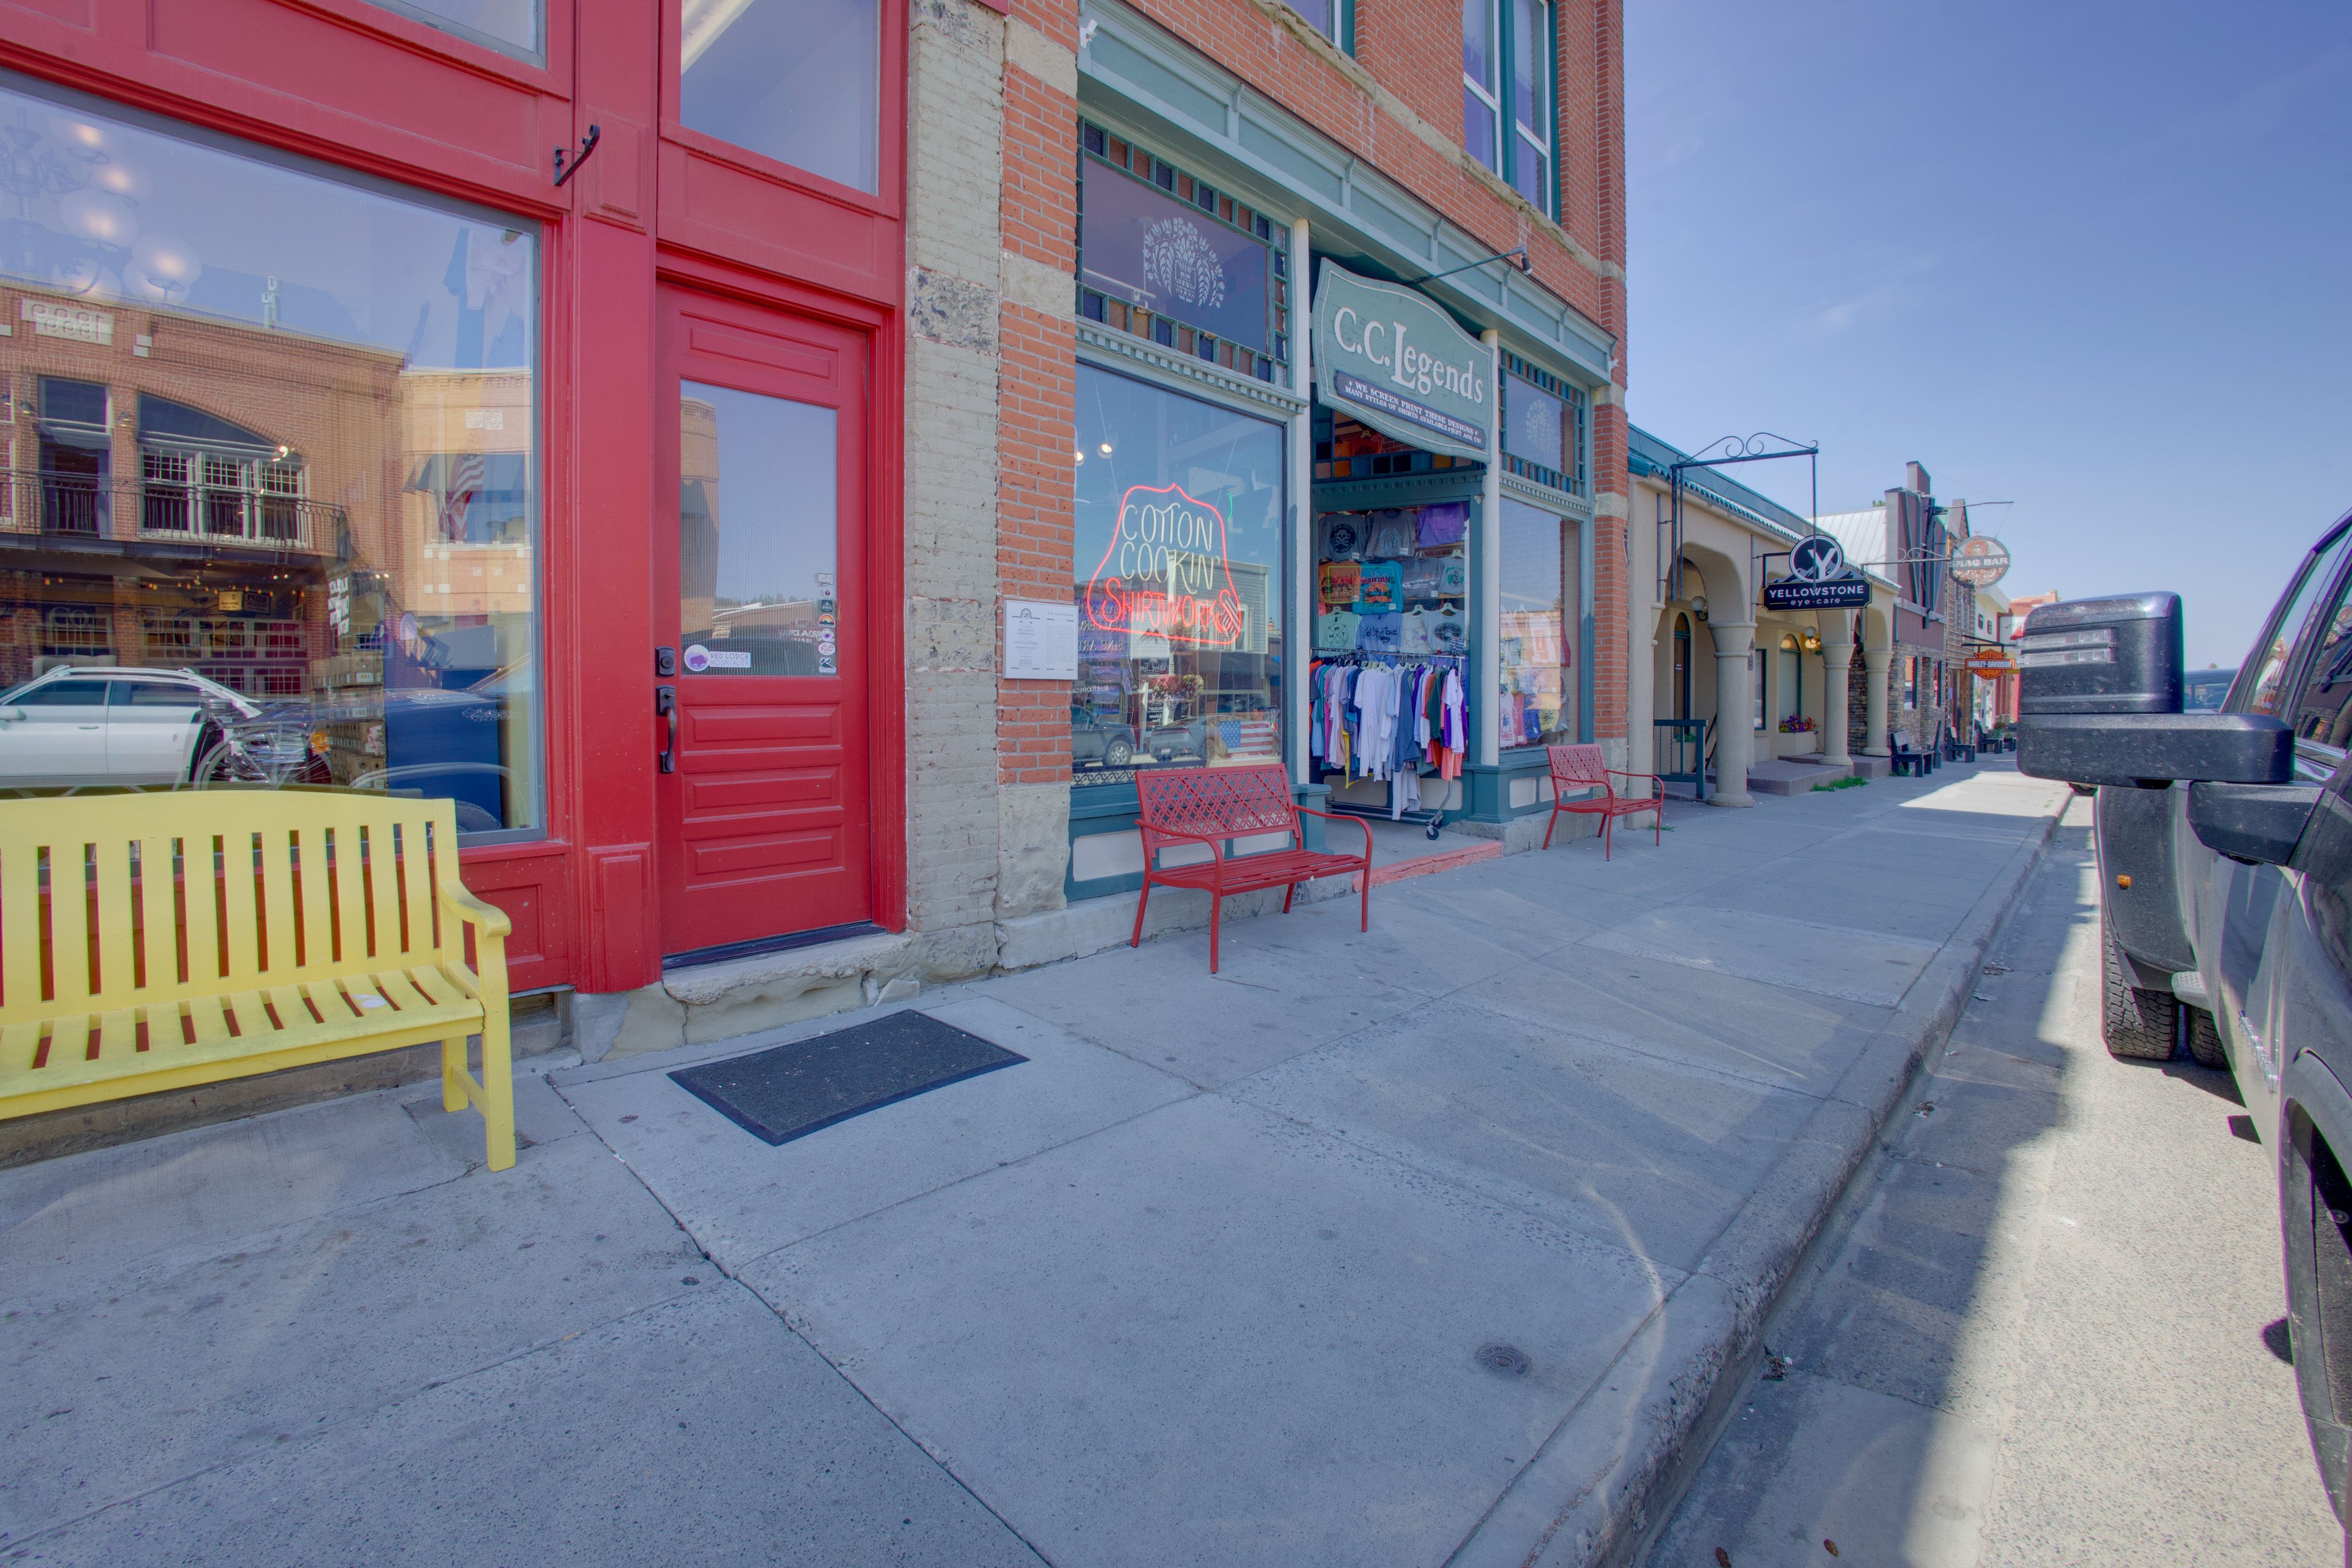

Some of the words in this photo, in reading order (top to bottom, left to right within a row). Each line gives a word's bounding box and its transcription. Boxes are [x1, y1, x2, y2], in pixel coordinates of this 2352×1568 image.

[1390, 321, 1483, 404] Legends
[1344, 386, 1363, 398] MANY
[1365, 394, 1387, 407] STYLES
[1398, 407, 1418, 419] SHIRTS
[1419, 415, 1447, 431] AVAILABLE
[1450, 427, 1462, 437] JUST
[1355, 382, 1368, 393] WE
[1370, 388, 1399, 405] SCREEN
[1401, 400, 1422, 415] PRINT
[1425, 409, 1446, 424] THESE
[1448, 419, 1474, 435] DESIGNS
[1121, 503, 1213, 552] COTTON
[1120, 541, 1221, 594] COOKIN'
[1948, 559, 1981, 568] SNAG
[1983, 557, 2008, 566] BAR
[1769, 585, 1864, 598] YELLOWSTONE
